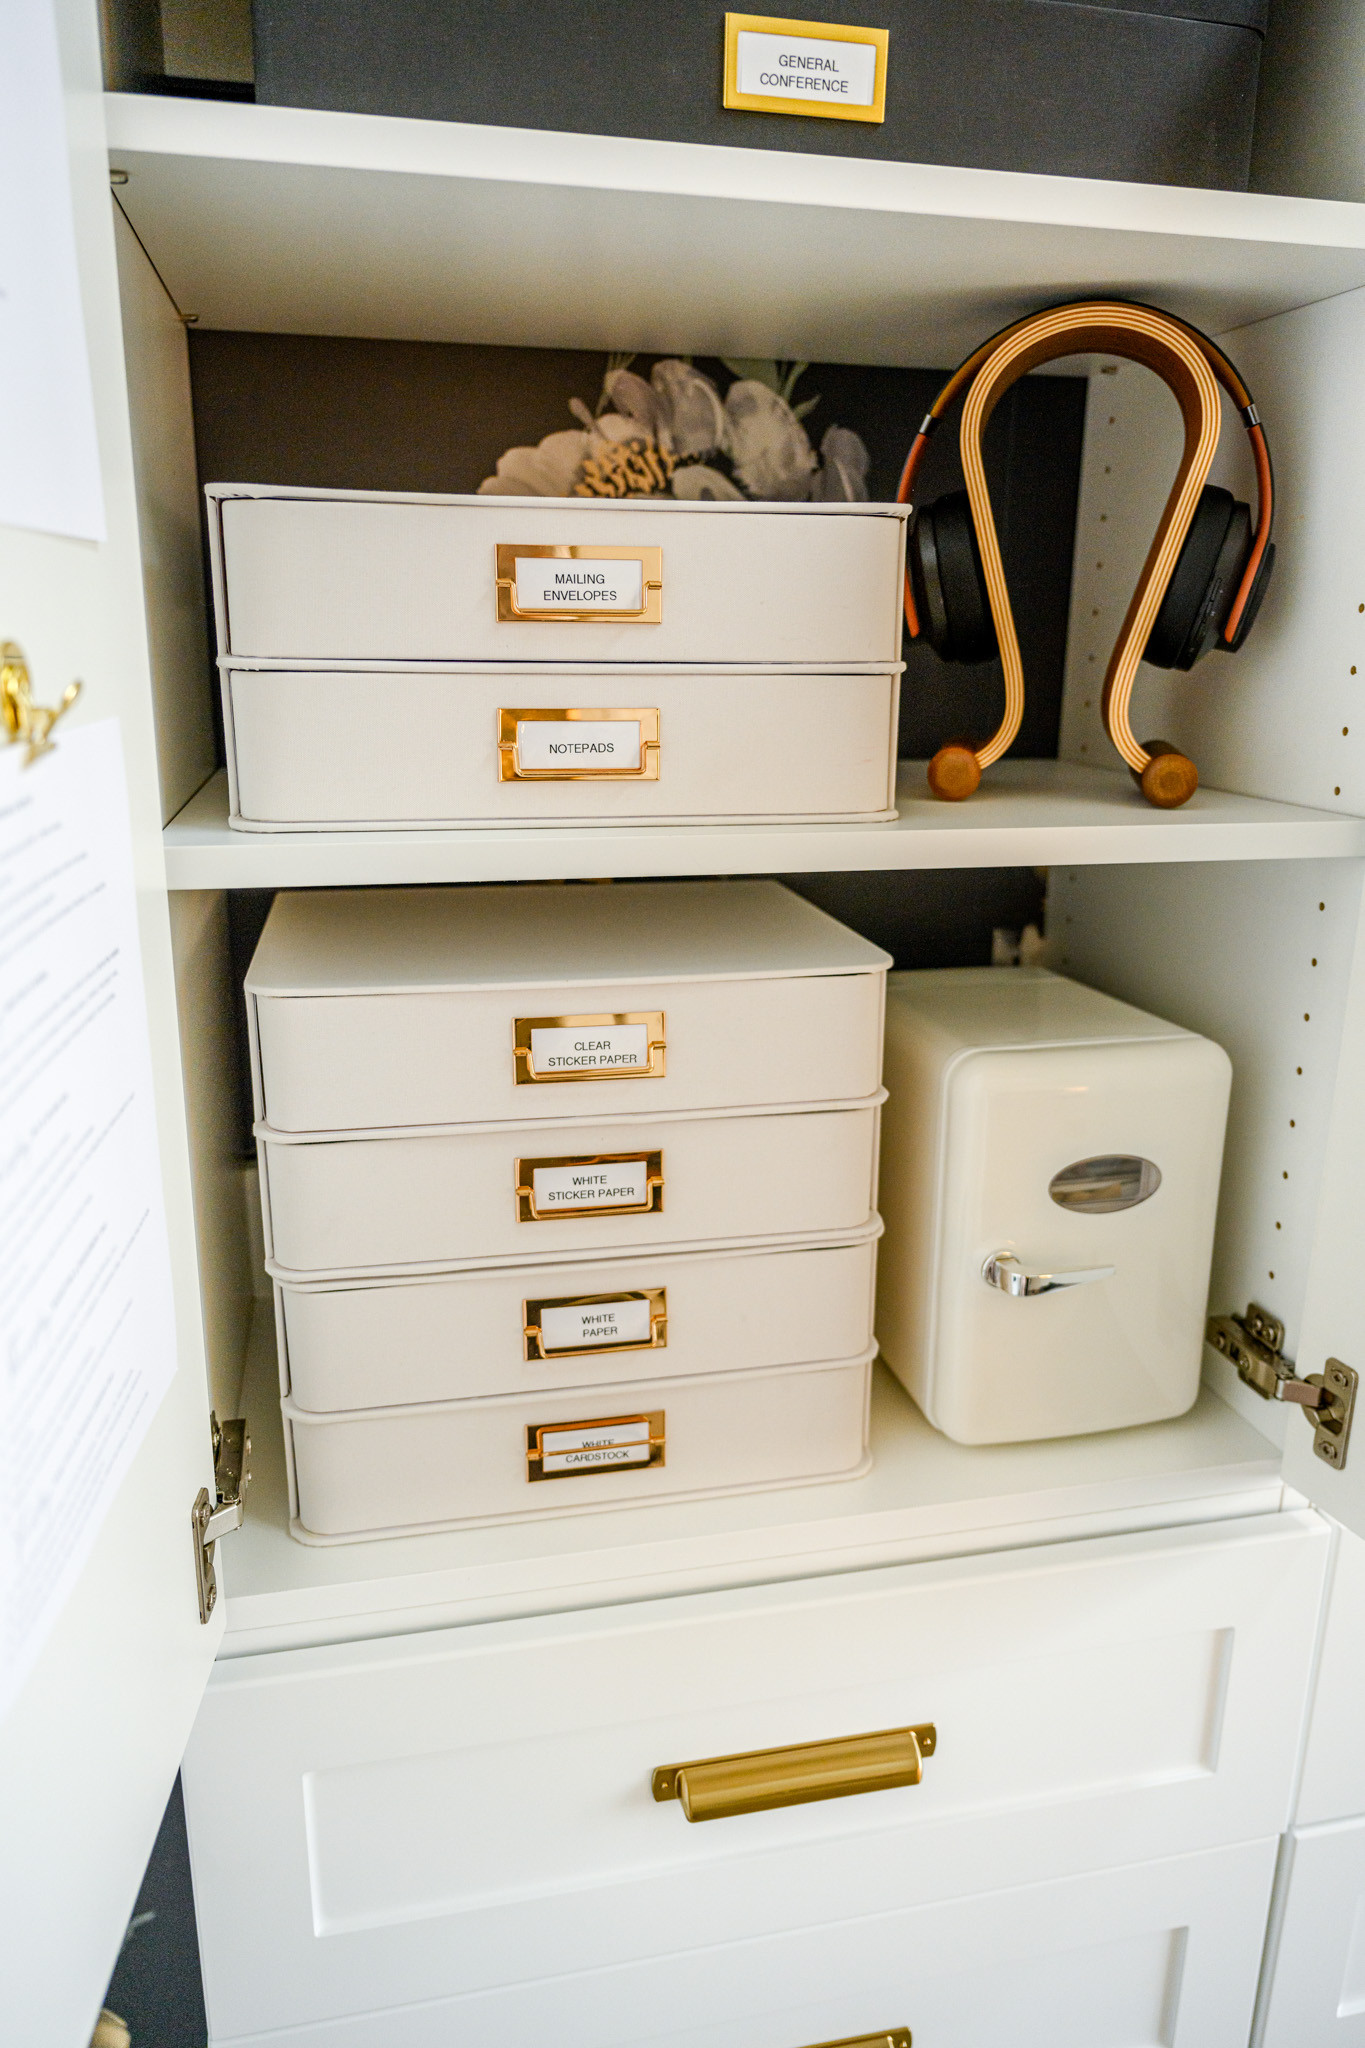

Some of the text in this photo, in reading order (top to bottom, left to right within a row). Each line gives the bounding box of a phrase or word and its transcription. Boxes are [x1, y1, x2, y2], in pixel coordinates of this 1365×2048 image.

[778, 55, 840, 73] GENERAL
[760, 73, 849, 94] CONFERENCE
[555, 574, 605, 585] MAILING
[543, 590, 618, 601] ENVELOPES
[549, 743, 615, 754] NOTEPADS
[574, 1041, 611, 1051] CLEAR
[548, 1054, 637, 1066] STICKER PAPER
[572, 1175, 608, 1186] WHITE
[548, 1187, 635, 1201] STICKER PAPER
[581, 1313, 616, 1324] WHITE
[582, 1326, 618, 1338] PAPER
[565, 1450, 630, 1463] CARDSTOCK
